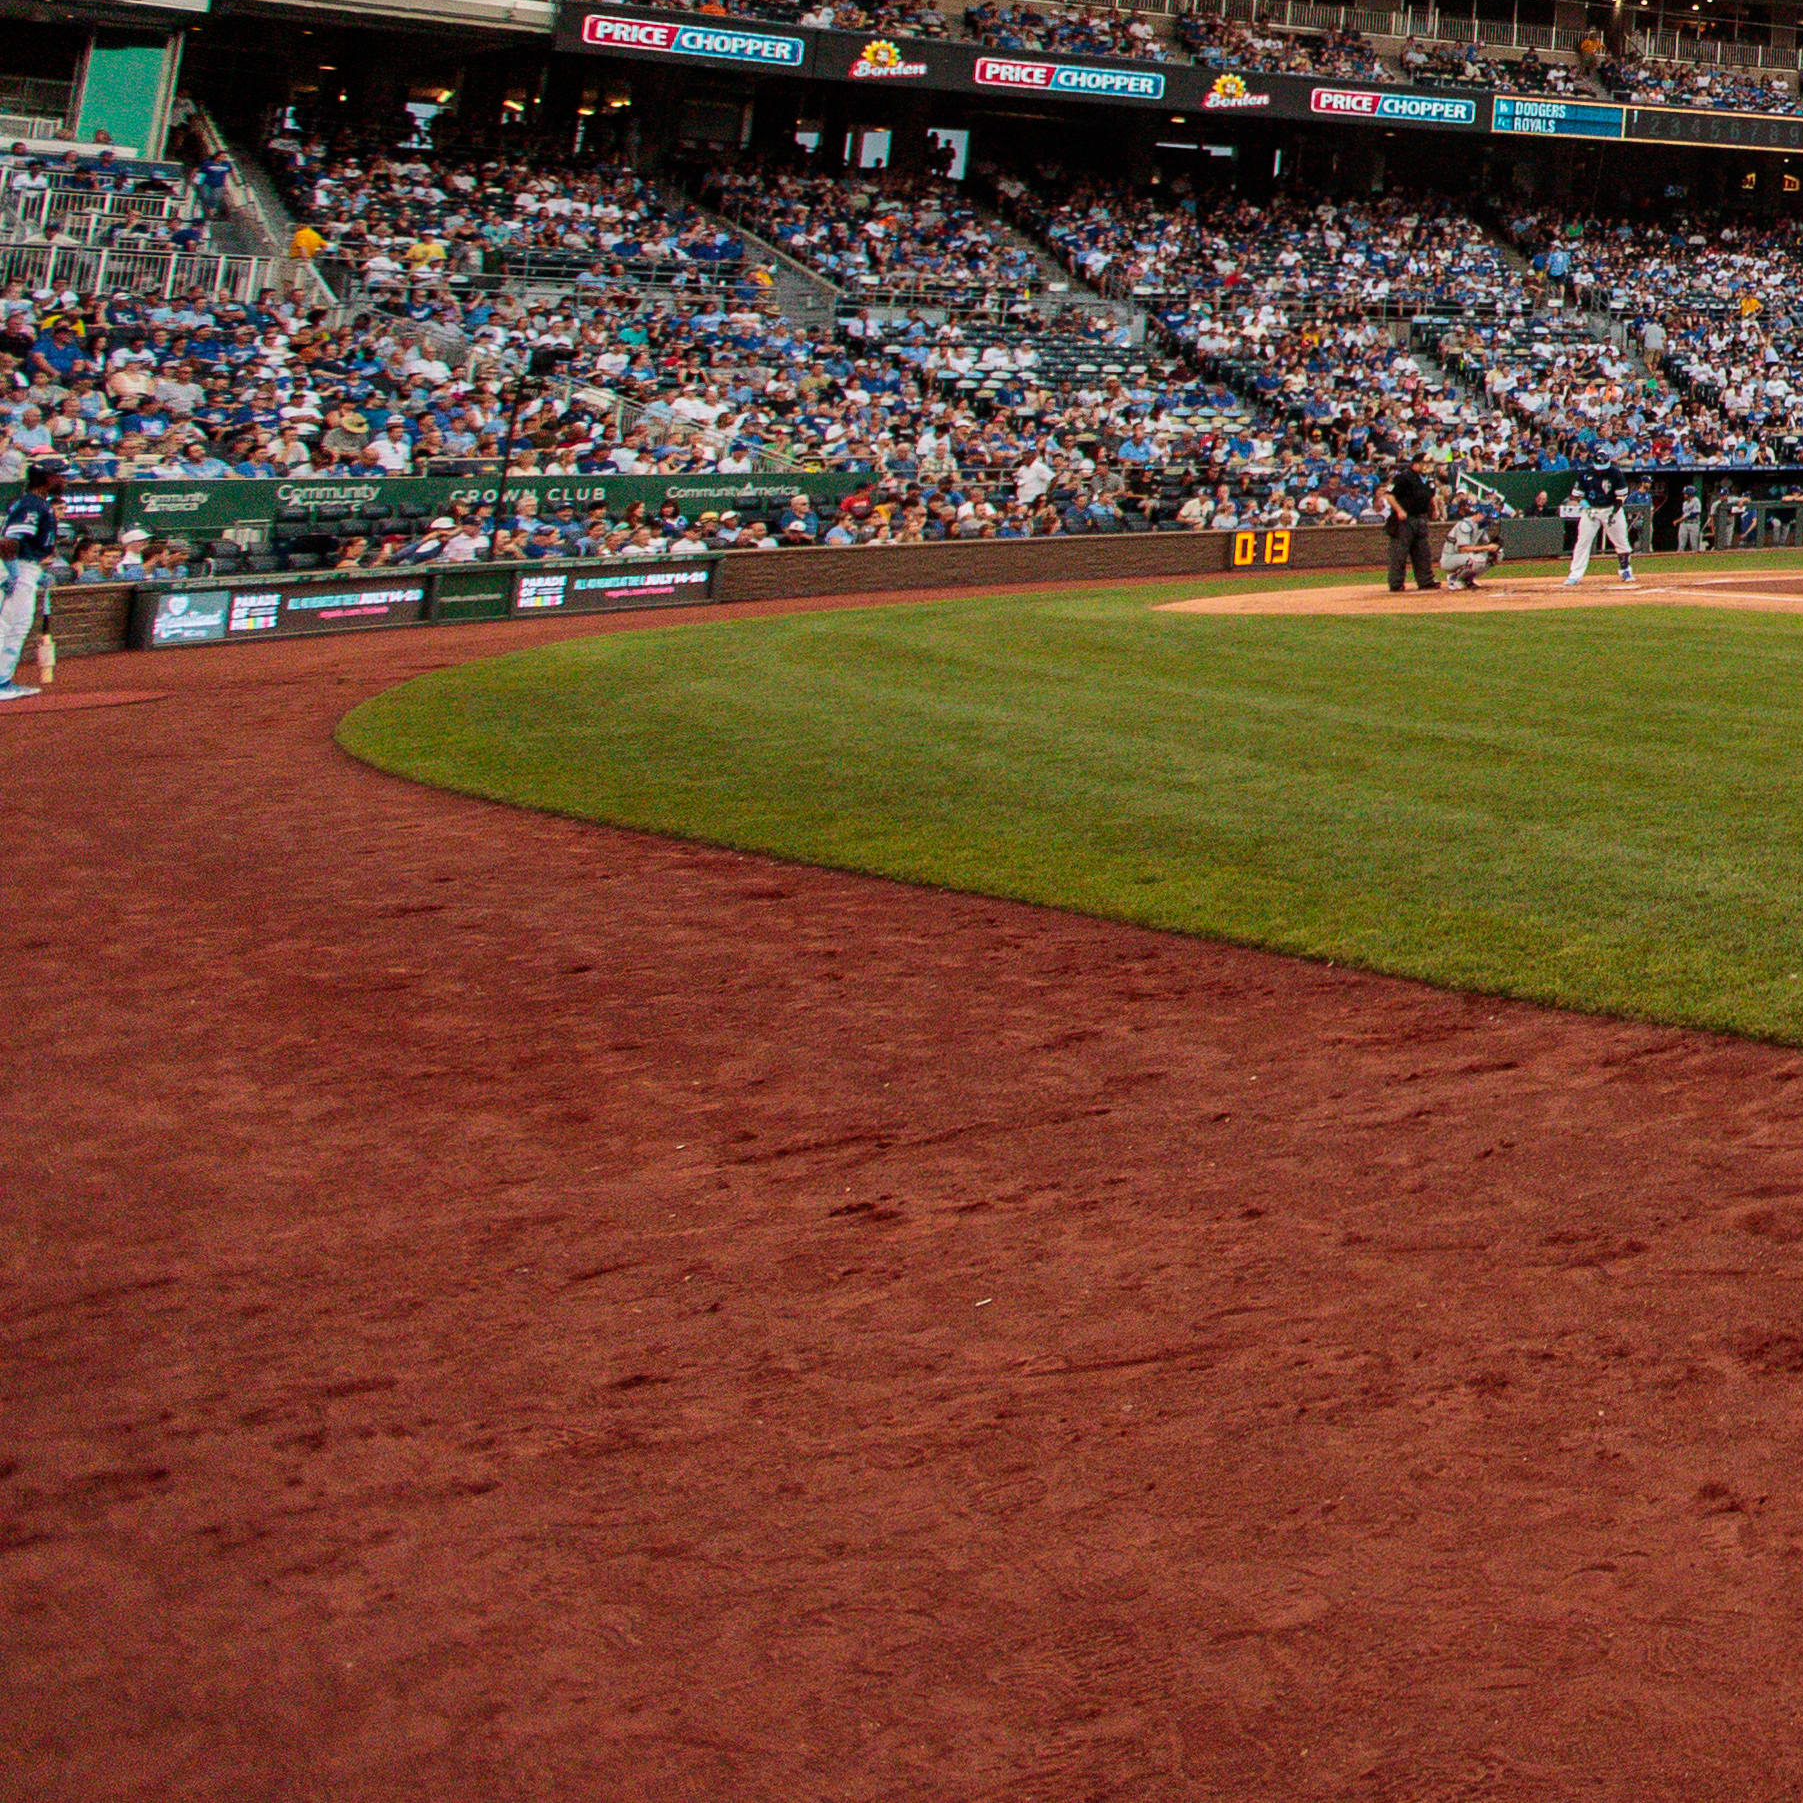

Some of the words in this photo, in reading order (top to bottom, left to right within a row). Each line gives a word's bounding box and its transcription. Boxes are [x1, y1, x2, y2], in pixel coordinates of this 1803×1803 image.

[595, 20, 668, 46] PRICE
[681, 31, 792, 60] CHOPPER
[853, 60, 927, 78] Borden
[985, 63, 1046, 85] PRICE
[1059, 70, 1155, 94] CHOPPER
[1206, 92, 1269, 108] Borden
[1319, 94, 1373, 113] PRICE
[1382, 98, 1467, 120] CHOPPER
[1514, 101, 1566, 119] DODGERS
[1513, 117, 1556, 134] ROYALS
[278, 484, 381, 502] Community
[451, 488, 539, 504] CROWN
[548, 487, 606, 502] CLUB
